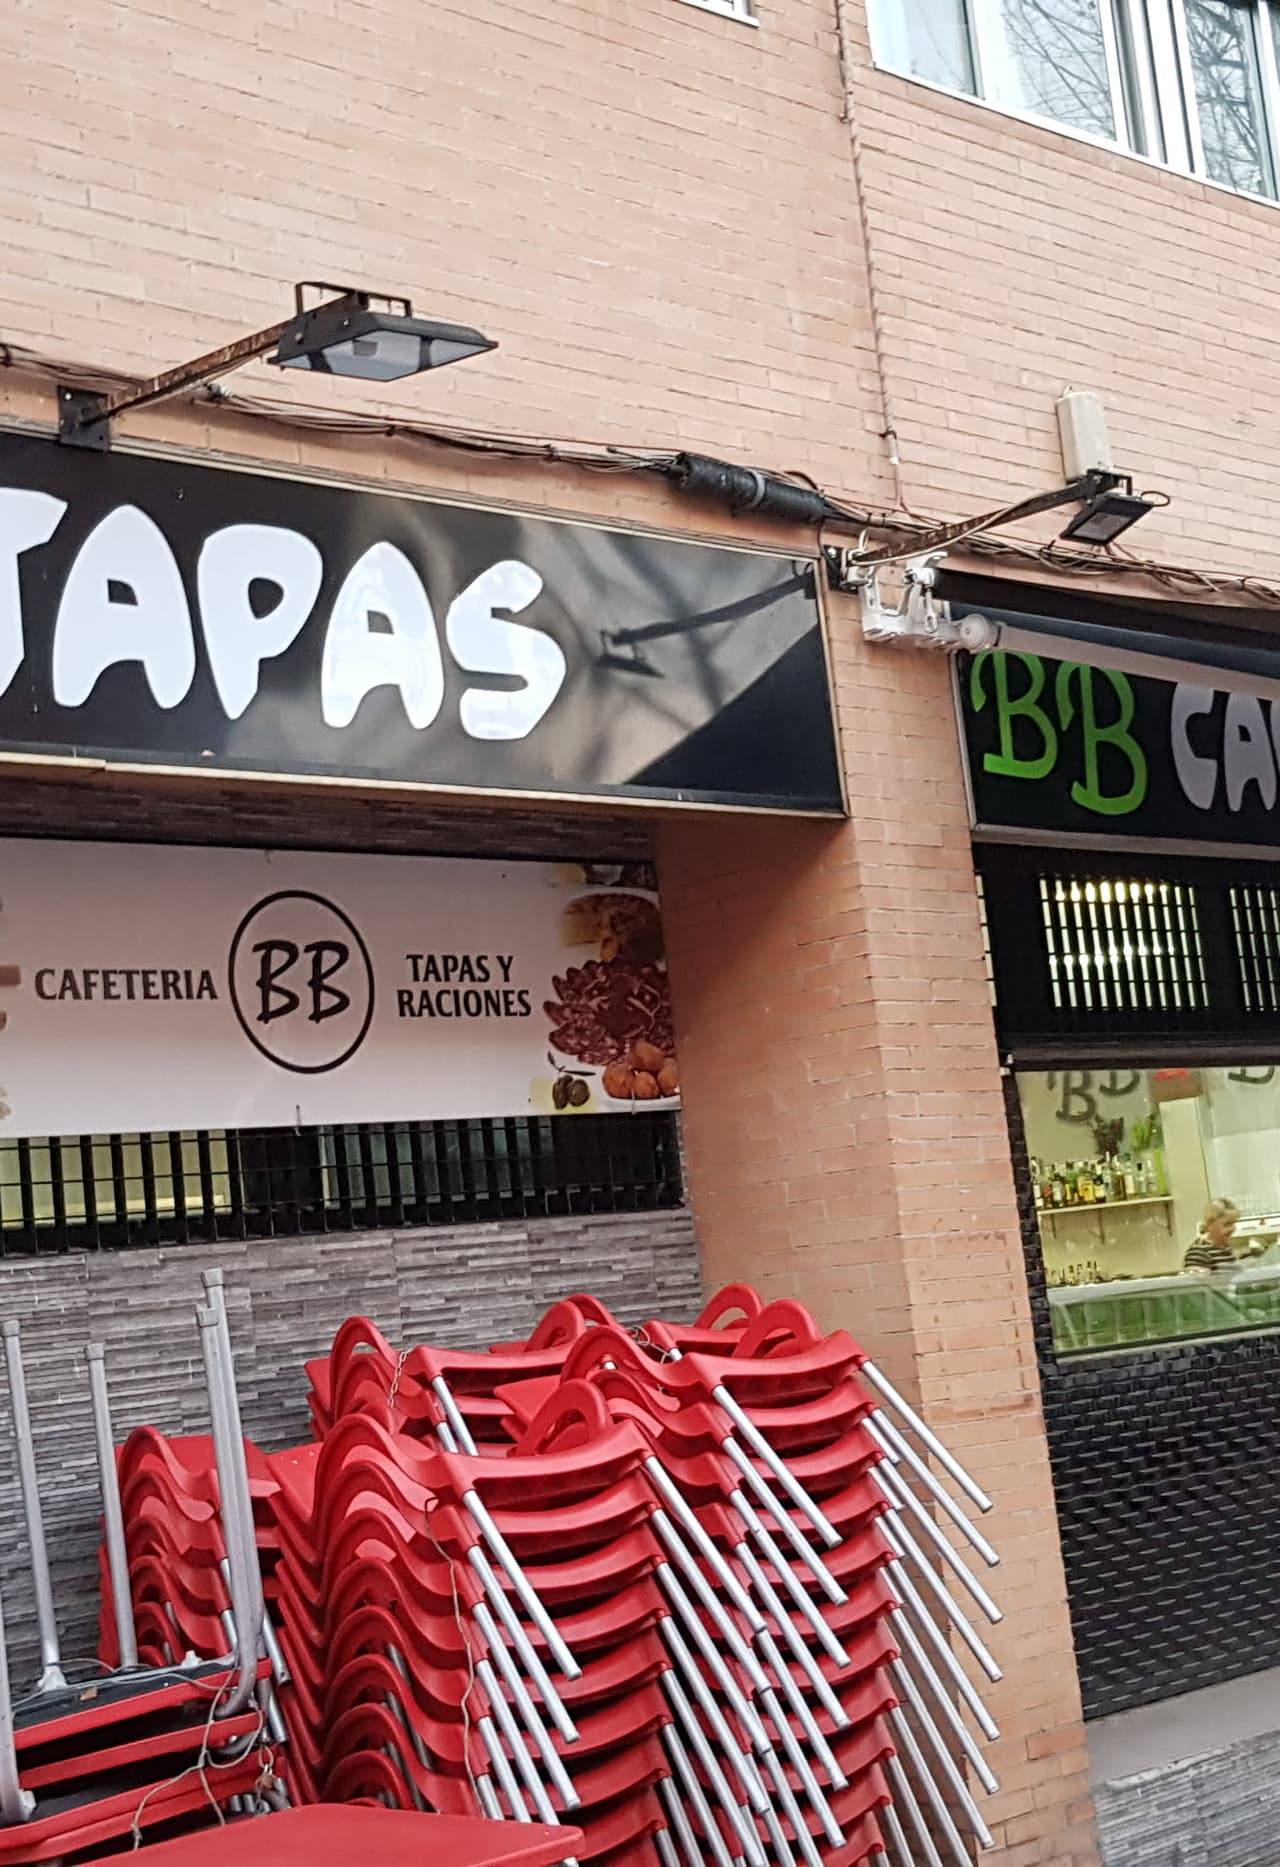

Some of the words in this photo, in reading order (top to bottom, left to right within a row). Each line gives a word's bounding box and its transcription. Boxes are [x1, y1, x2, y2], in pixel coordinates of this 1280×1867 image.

[971, 649, 1148, 815] BB
[252, 939, 351, 1024] BB
[406, 953, 490, 982] TAPAS
[497, 954, 514, 980] Y
[34, 968, 218, 1000] CAFETERIA
[397, 989, 532, 1018] RACIONES
